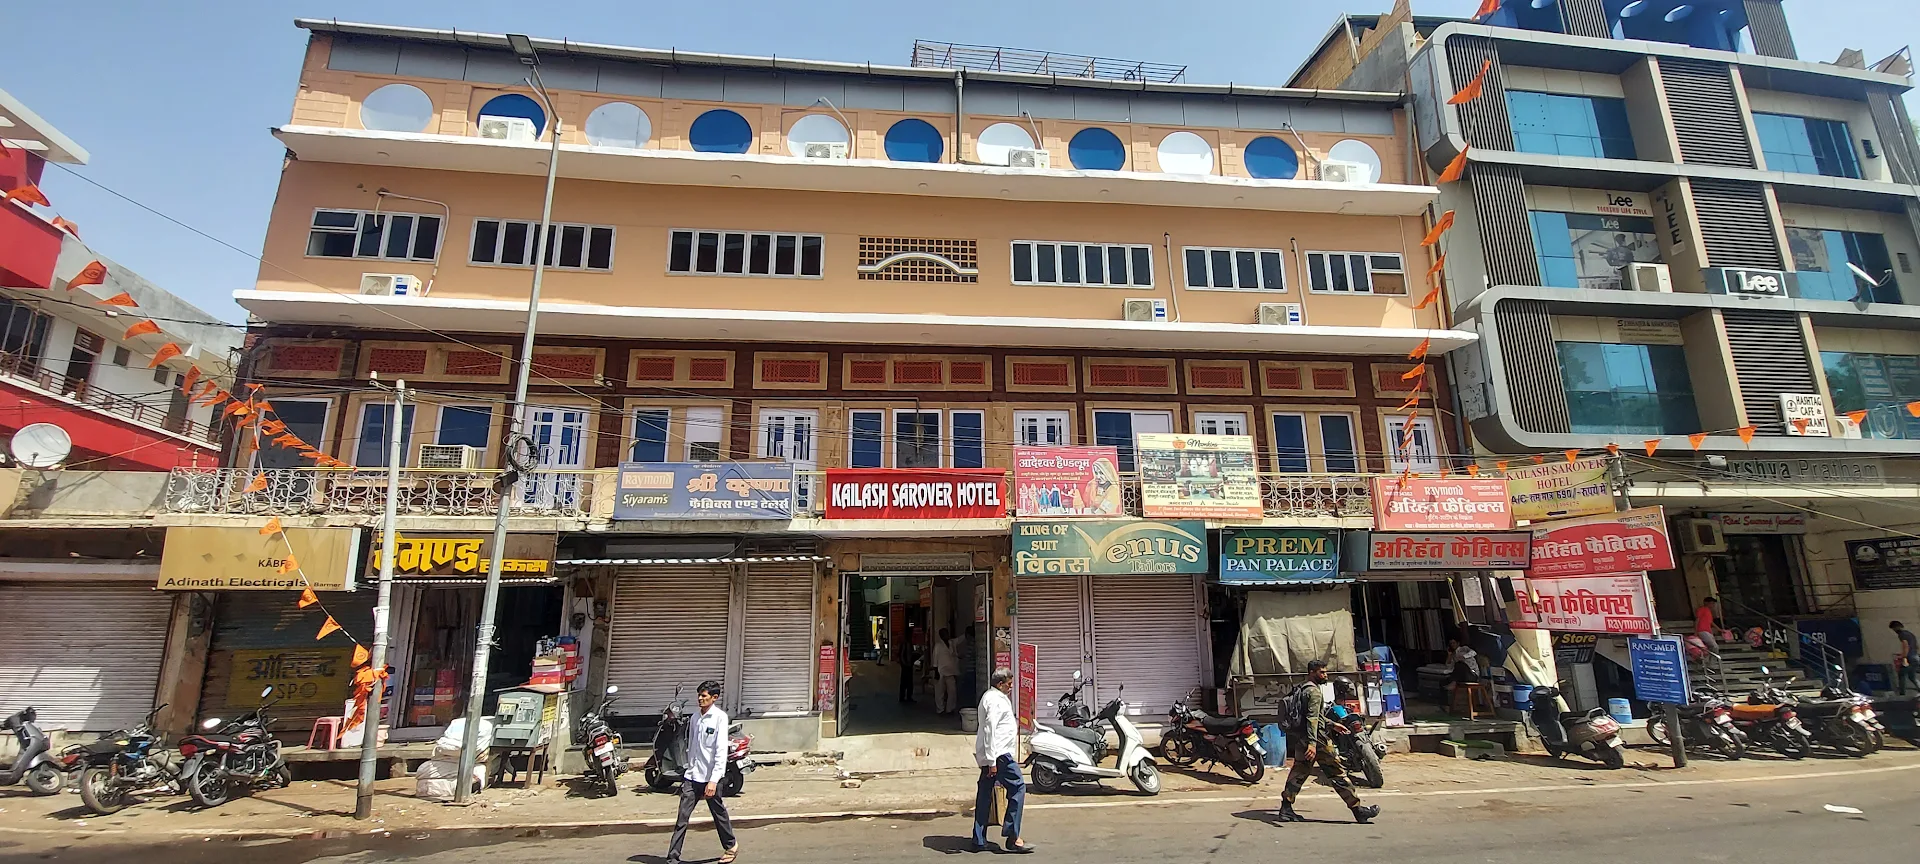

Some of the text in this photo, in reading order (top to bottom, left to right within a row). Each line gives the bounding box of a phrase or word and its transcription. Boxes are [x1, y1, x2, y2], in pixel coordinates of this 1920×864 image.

[1607, 193, 1633, 207] Lee
[1601, 217, 1620, 229] Lee
[1736, 271, 1779, 293] Lee
[1796, 395, 1821, 406] HASHTAG
[1801, 406, 1815, 416] CAFE
[1506, 459, 1605, 481] KAILASH SAROVER
[1799, 459, 1879, 479] Pratham
[685, 473, 791, 498] श्री कृष्णा
[1537, 476, 1572, 490] HOTEL
[832, 482, 1000, 509] KAILASH SAROVER HOTEL
[1424, 484, 1464, 498] Raymond
[1389, 497, 1439, 513] अरिहंत
[1020, 524, 1069, 536] KING OF
[1031, 540, 1059, 551] SUIT
[1072, 522, 1203, 564] Venus
[1234, 537, 1326, 555] PREM
[1374, 536, 1527, 558] अरिहंत फैब्रिक्स
[1128, 560, 1177, 573] Tailors
[1226, 558, 1333, 571] PAN PALACE
[165, 577, 224, 587] Adinath
[228, 577, 307, 588] Electricals
[1607, 618, 1651, 632] Raymond
[1561, 633, 1596, 644] Store
[1812, 631, 1827, 644] SBI
[1631, 642, 1676, 652] RANGMER
